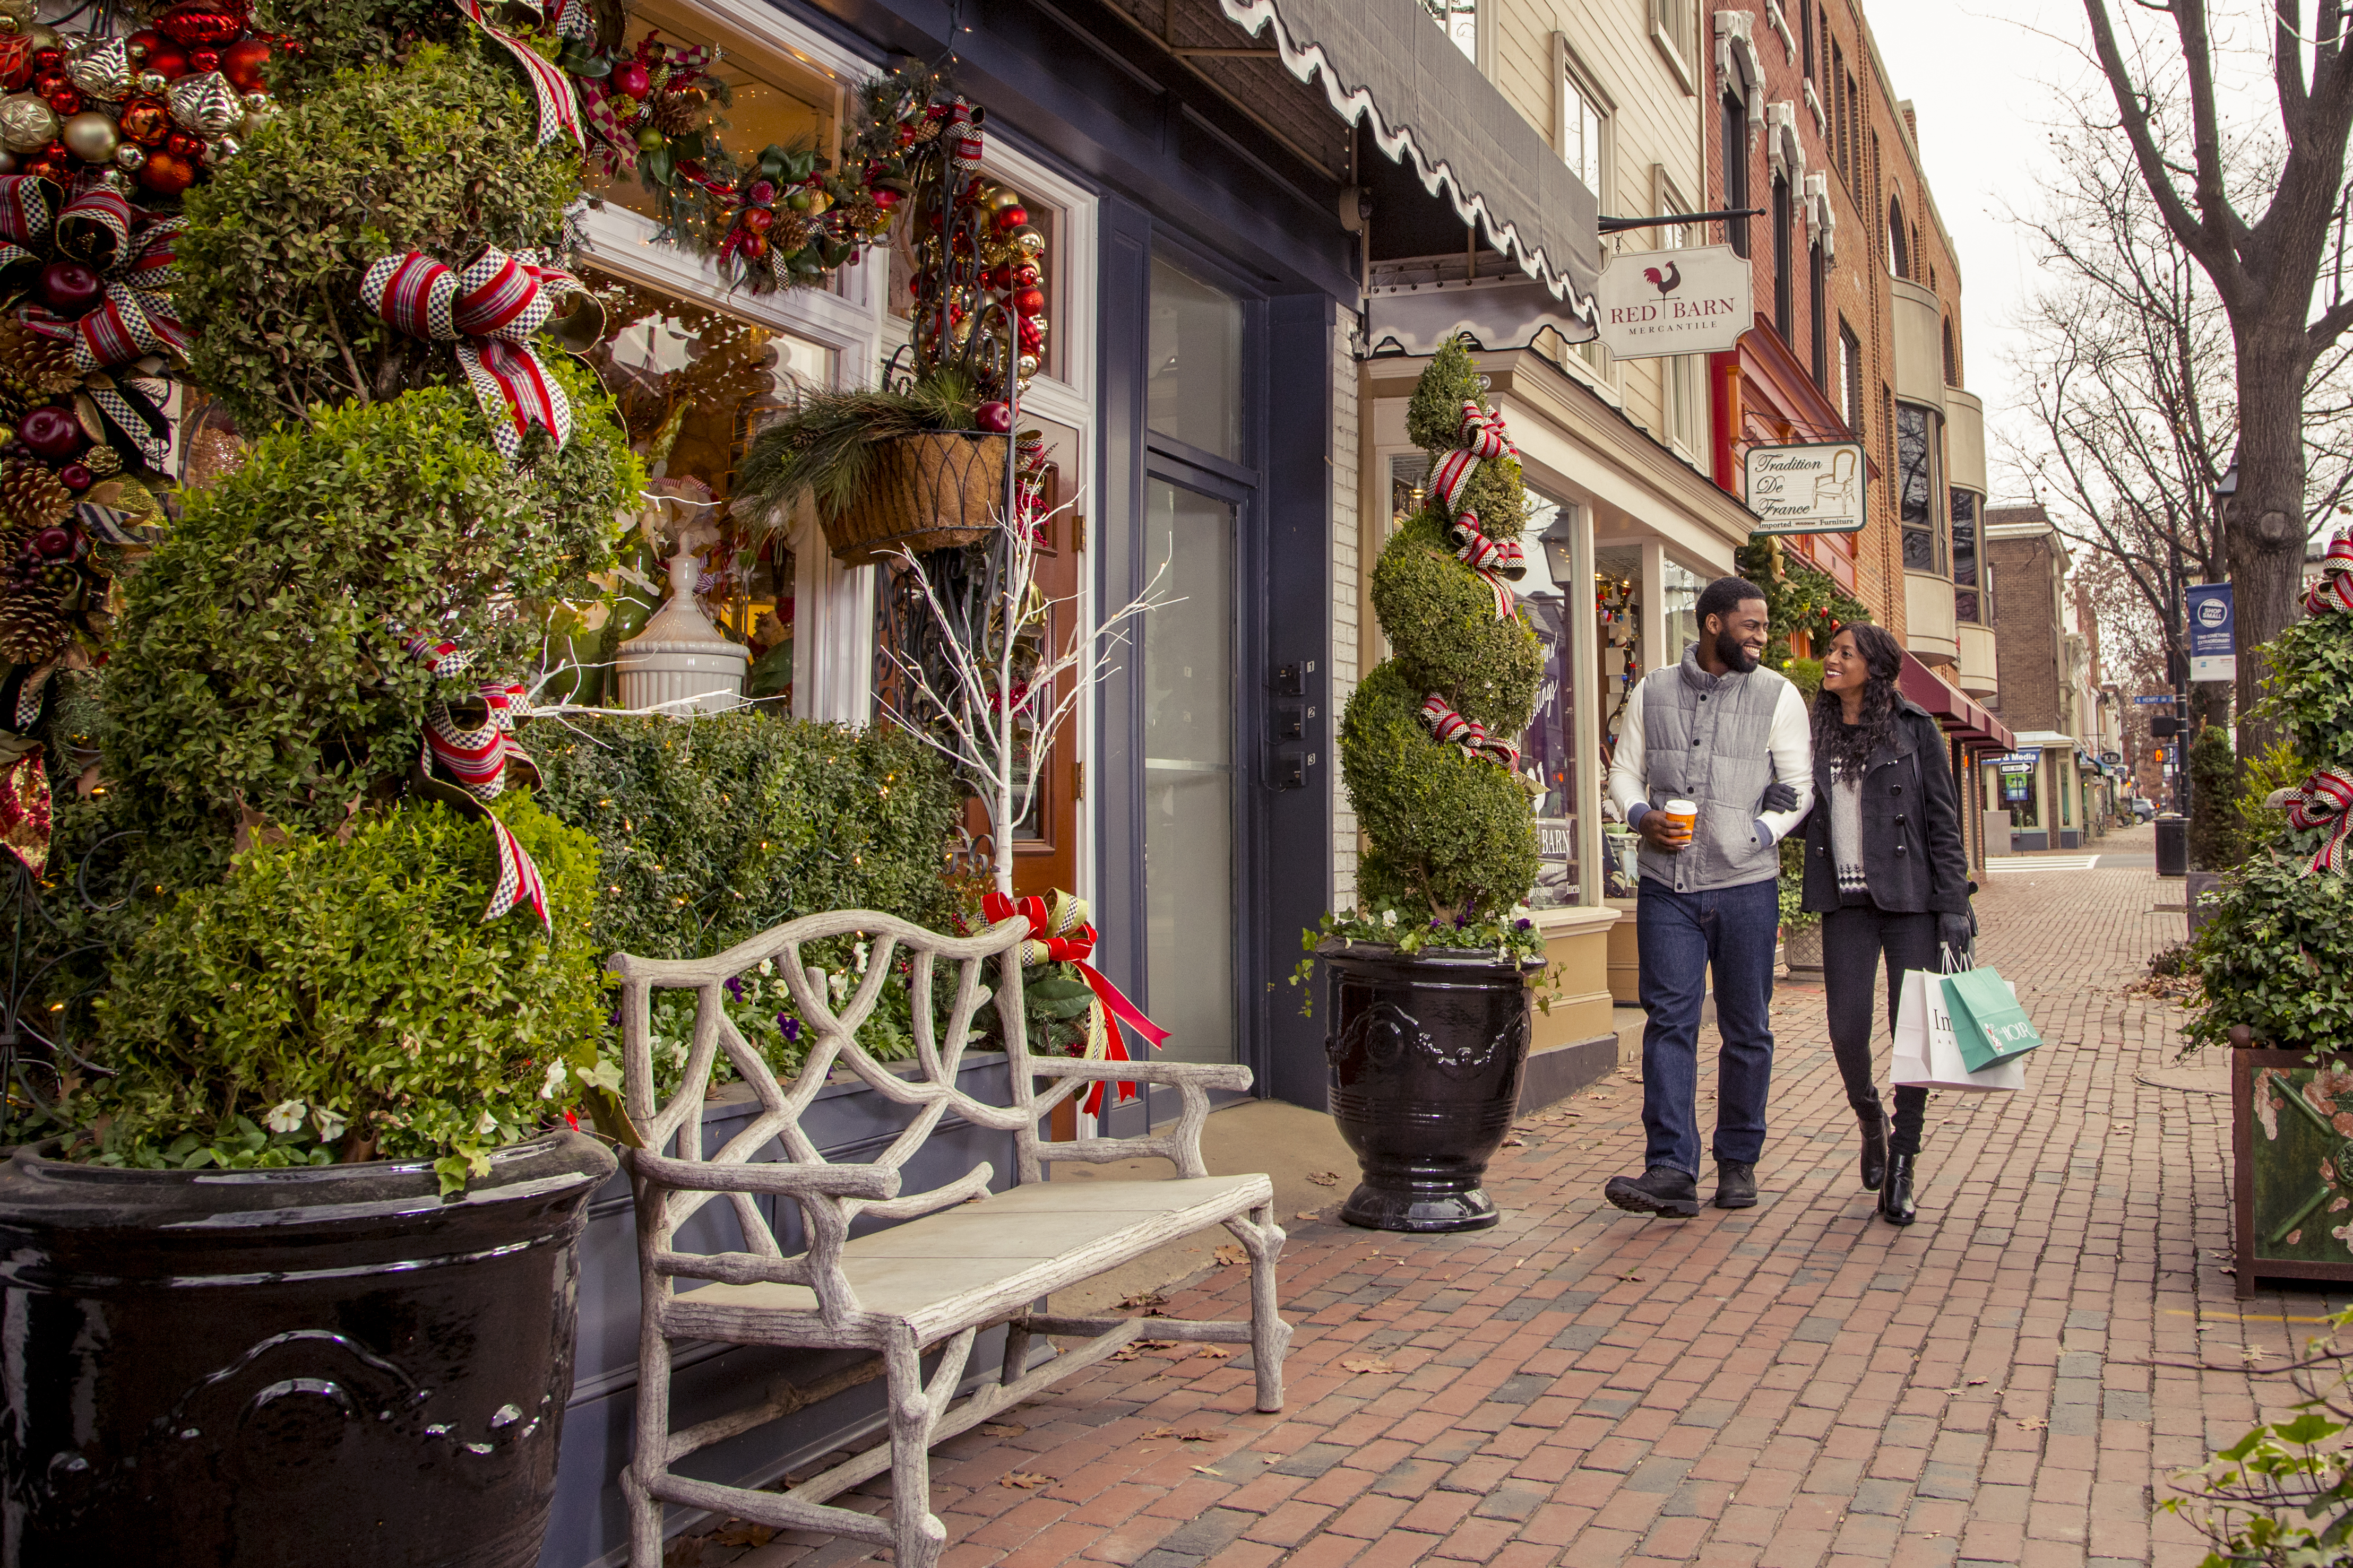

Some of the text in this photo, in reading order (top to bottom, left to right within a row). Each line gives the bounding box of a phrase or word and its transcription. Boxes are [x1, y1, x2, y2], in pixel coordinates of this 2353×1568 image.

[1610, 297, 1736, 324] RED BARN
[1628, 320, 1718, 335] MERCANTILE
[1755, 454, 1823, 472] Tradition
[1755, 475, 1785, 494] De
[1755, 498, 1810, 516] France
[1759, 521, 1791, 530] Imported
[1309, 662, 1313, 671] 1
[1309, 707, 1314, 717] 2
[1309, 754, 1314, 764] 3
[1541, 829, 1570, 854] BARN
[1529, 881, 1580, 902] provisions linens
[2001, 1021, 2038, 1042] HOUR
